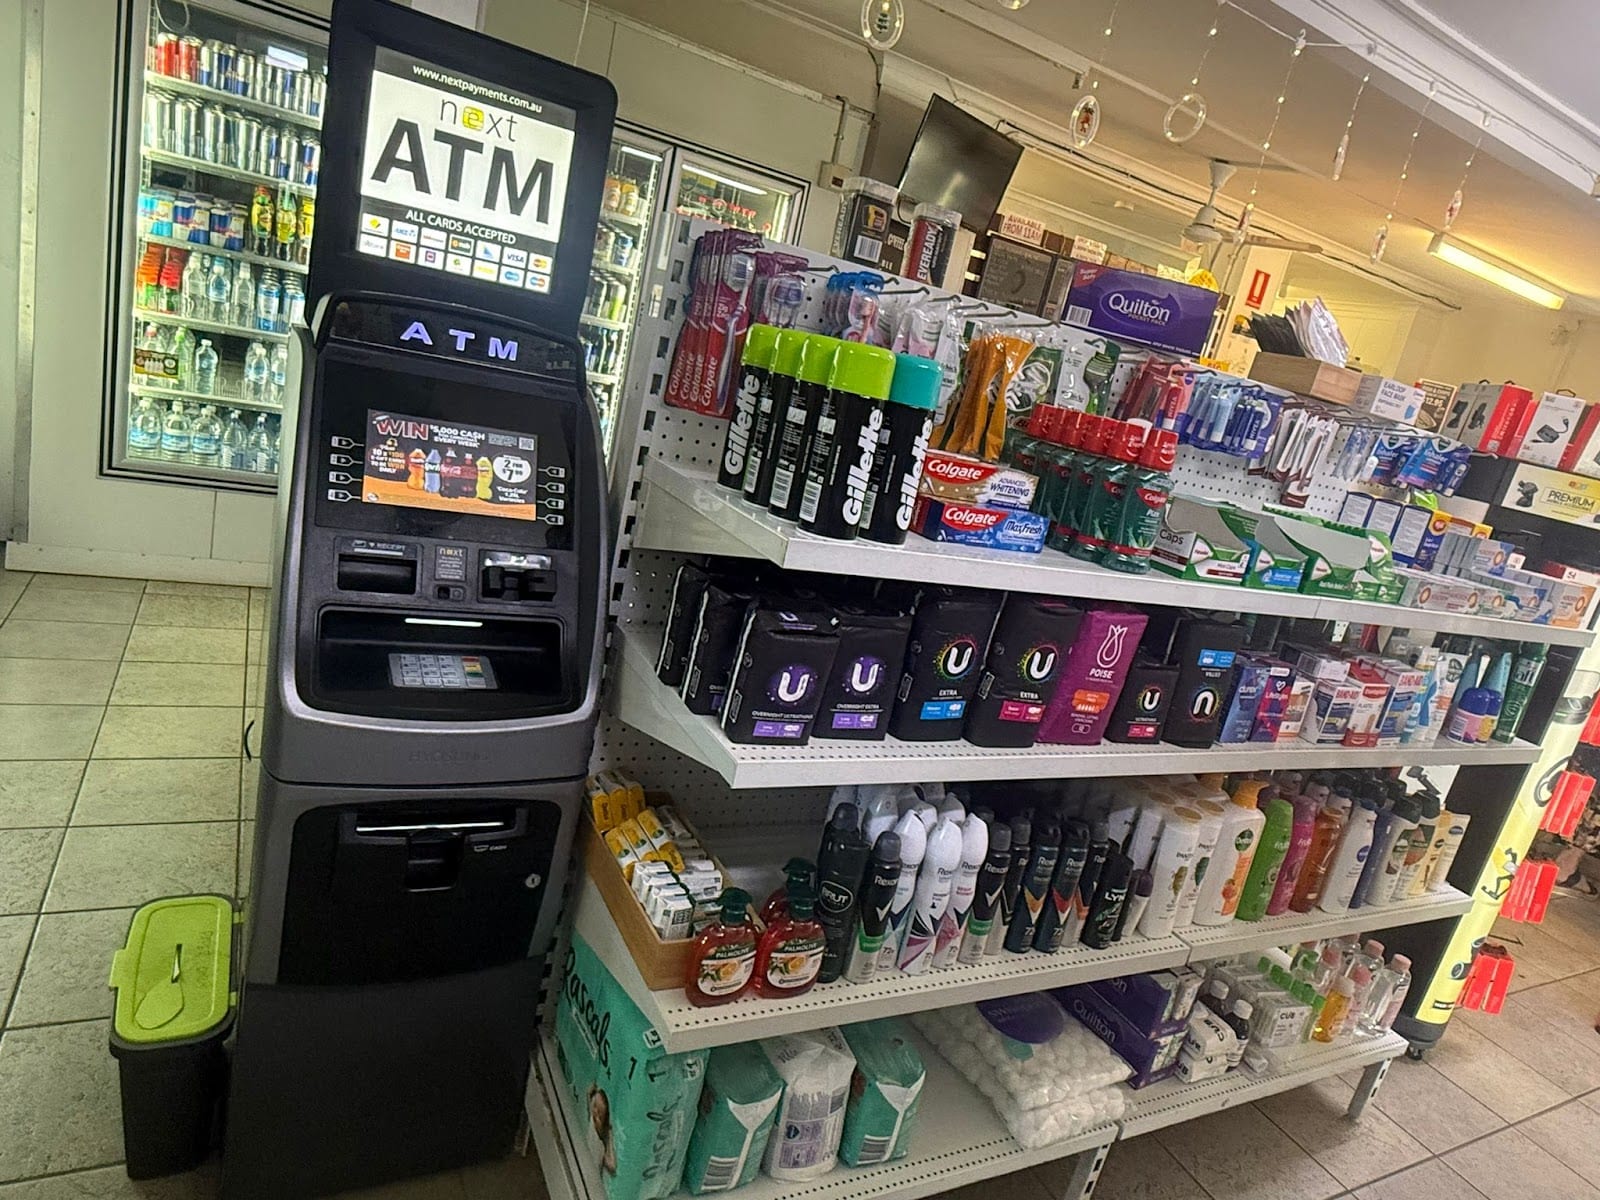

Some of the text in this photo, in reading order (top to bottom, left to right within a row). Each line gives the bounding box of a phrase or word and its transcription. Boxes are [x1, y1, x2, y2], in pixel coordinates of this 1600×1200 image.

[412, 64, 542, 113] www.nextpayments.com.au
[440, 98, 518, 142] next
[371, 118, 554, 225] ATM
[405, 209, 517, 245] ALL CARDS ACCEPTED
[1003, 222, 1023, 235] FROM
[1008, 215, 1042, 231] AVAILABLE
[507, 252, 525, 264] VISA
[917, 221, 939, 281] EVEREADY
[1108, 292, 1171, 322] Quilton
[400, 320, 519, 362] ATM
[701, 356, 719, 407] Colgate
[376, 418, 429, 441] WIN
[460, 429, 486, 441] CASH
[724, 374, 762, 476] Gillette
[433, 436, 457, 446] EVERY
[503, 459, 511, 469] 2
[842, 407, 884, 525] Gillette
[896, 418, 934, 531] Gillette
[927, 459, 983, 481] Colgate
[989, 482, 1031, 498] WHITENING
[998, 478, 1027, 488] ADVANCED
[1548, 490, 1596, 509] PREMIUM
[945, 506, 998, 526] Colgate
[1159, 529, 1185, 545] Caps
[946, 646, 973, 674] U
[1029, 652, 1055, 680] U
[851, 662, 879, 693] U
[1088, 668, 1115, 680] POISE
[776, 671, 810, 703] U
[939, 689, 958, 697] EXTRA
[1020, 691, 1039, 700] EXTRA
[1143, 692, 1161, 711] U
[961, 861, 981, 870] Rexo
[874, 875, 898, 887] Rexo
[1104, 892, 1126, 902] LYN
[715, 947, 750, 959] PALMOLIVE
[784, 942, 817, 952] PALMOLIVE
[562, 946, 611, 1068] Rascals
[1073, 999, 1117, 1044] Quilton
